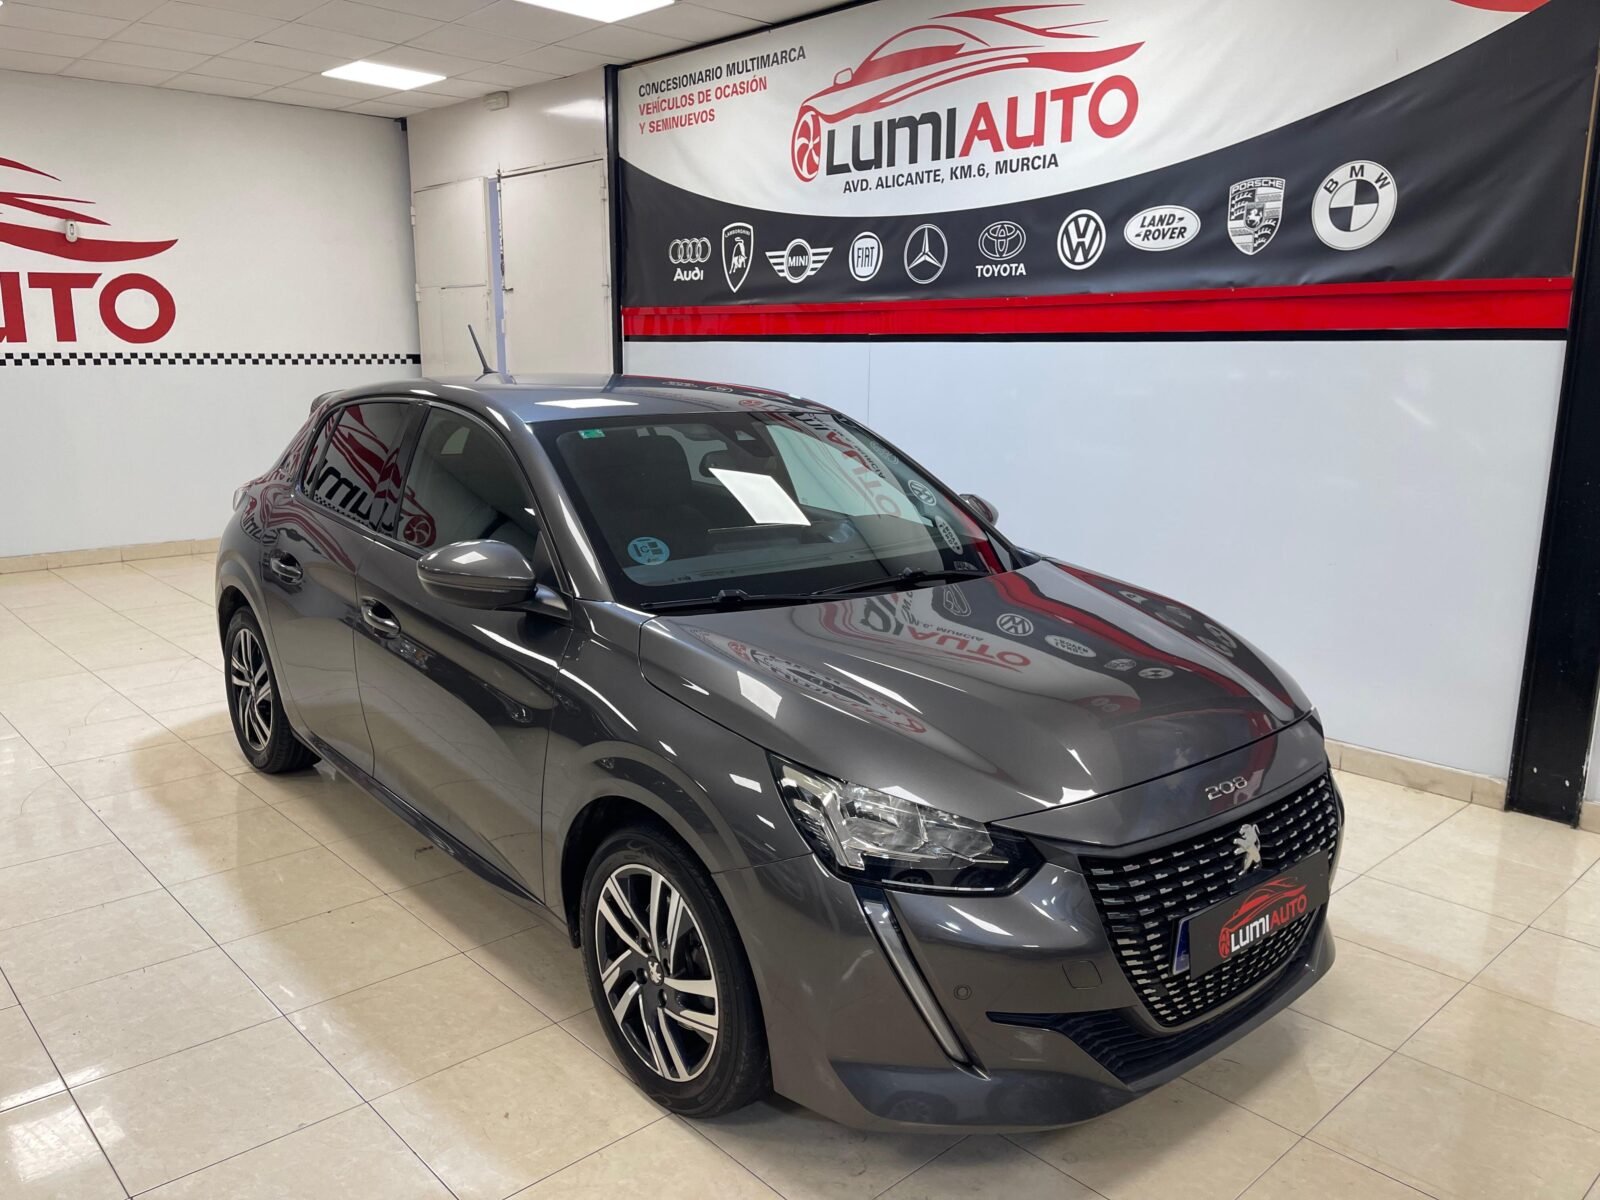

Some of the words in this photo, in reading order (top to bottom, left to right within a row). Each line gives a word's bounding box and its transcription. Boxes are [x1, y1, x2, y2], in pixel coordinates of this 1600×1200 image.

[638, 66, 722, 97] CONCESIONARIO
[726, 46, 806, 77] MULTIMARCA
[639, 93, 695, 116] VEHÍCULOS
[697, 89, 711, 103] DE
[715, 75, 768, 100] OCASIÓN
[639, 122, 646, 135] Y
[648, 108, 715, 133] SEMINUEVOS
[843, 176, 872, 194] AVD.
[875, 169, 945, 190] ALICANTE,
[995, 153, 1059, 175] MURCIA
[1231, 179, 1283, 194] PORSCHE
[788, 255, 808, 267] MINI
[856, 246, 875, 268] FIAT
[673, 267, 704, 281] Audi
[976, 263, 1027, 278] TOYOTA
[1205, 776, 1248, 801] 208
